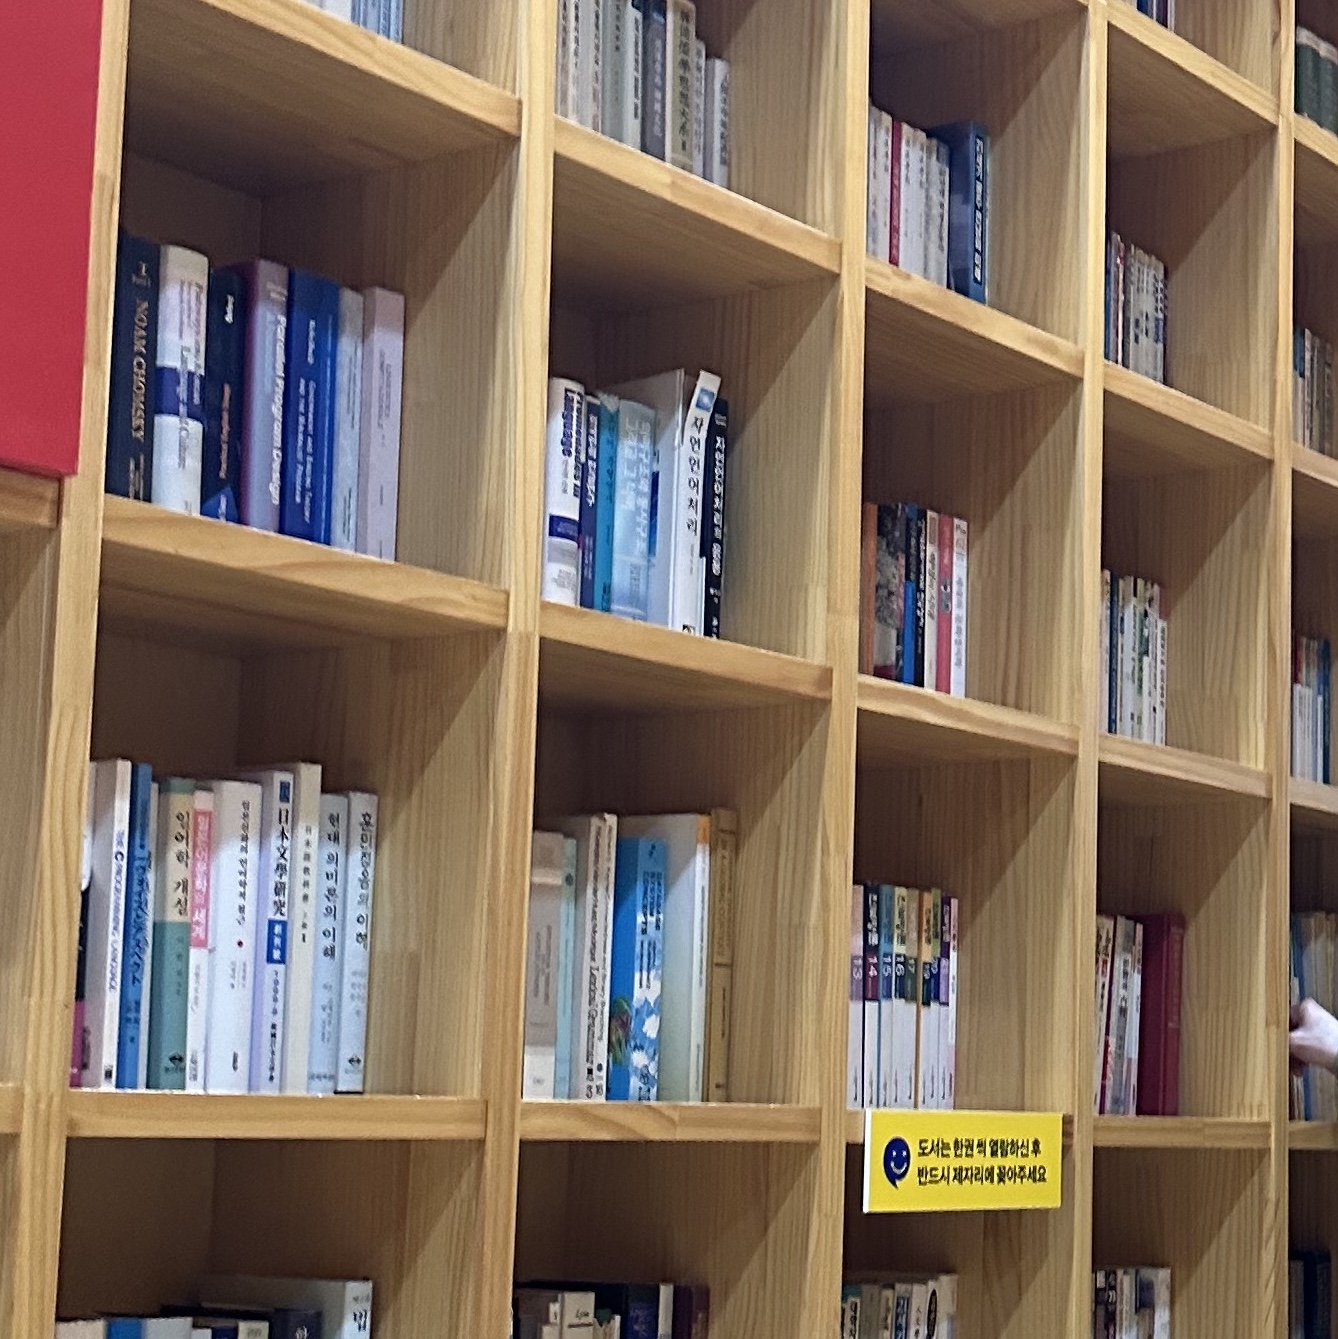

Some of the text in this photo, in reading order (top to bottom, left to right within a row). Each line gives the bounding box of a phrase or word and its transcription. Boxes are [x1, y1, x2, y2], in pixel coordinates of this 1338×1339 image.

[132, 299, 149, 352] NOAM
[131, 356, 147, 442] CHOMSKY
[268, 313, 287, 506] Parallel Program Design
[174, 811, 190, 868] 언어학
[917, 1137, 1042, 1158] 도서는 한권 씩 열람하신 후
[917, 1165, 1048, 1186] 반드시 제자리에 꽂아주세요
